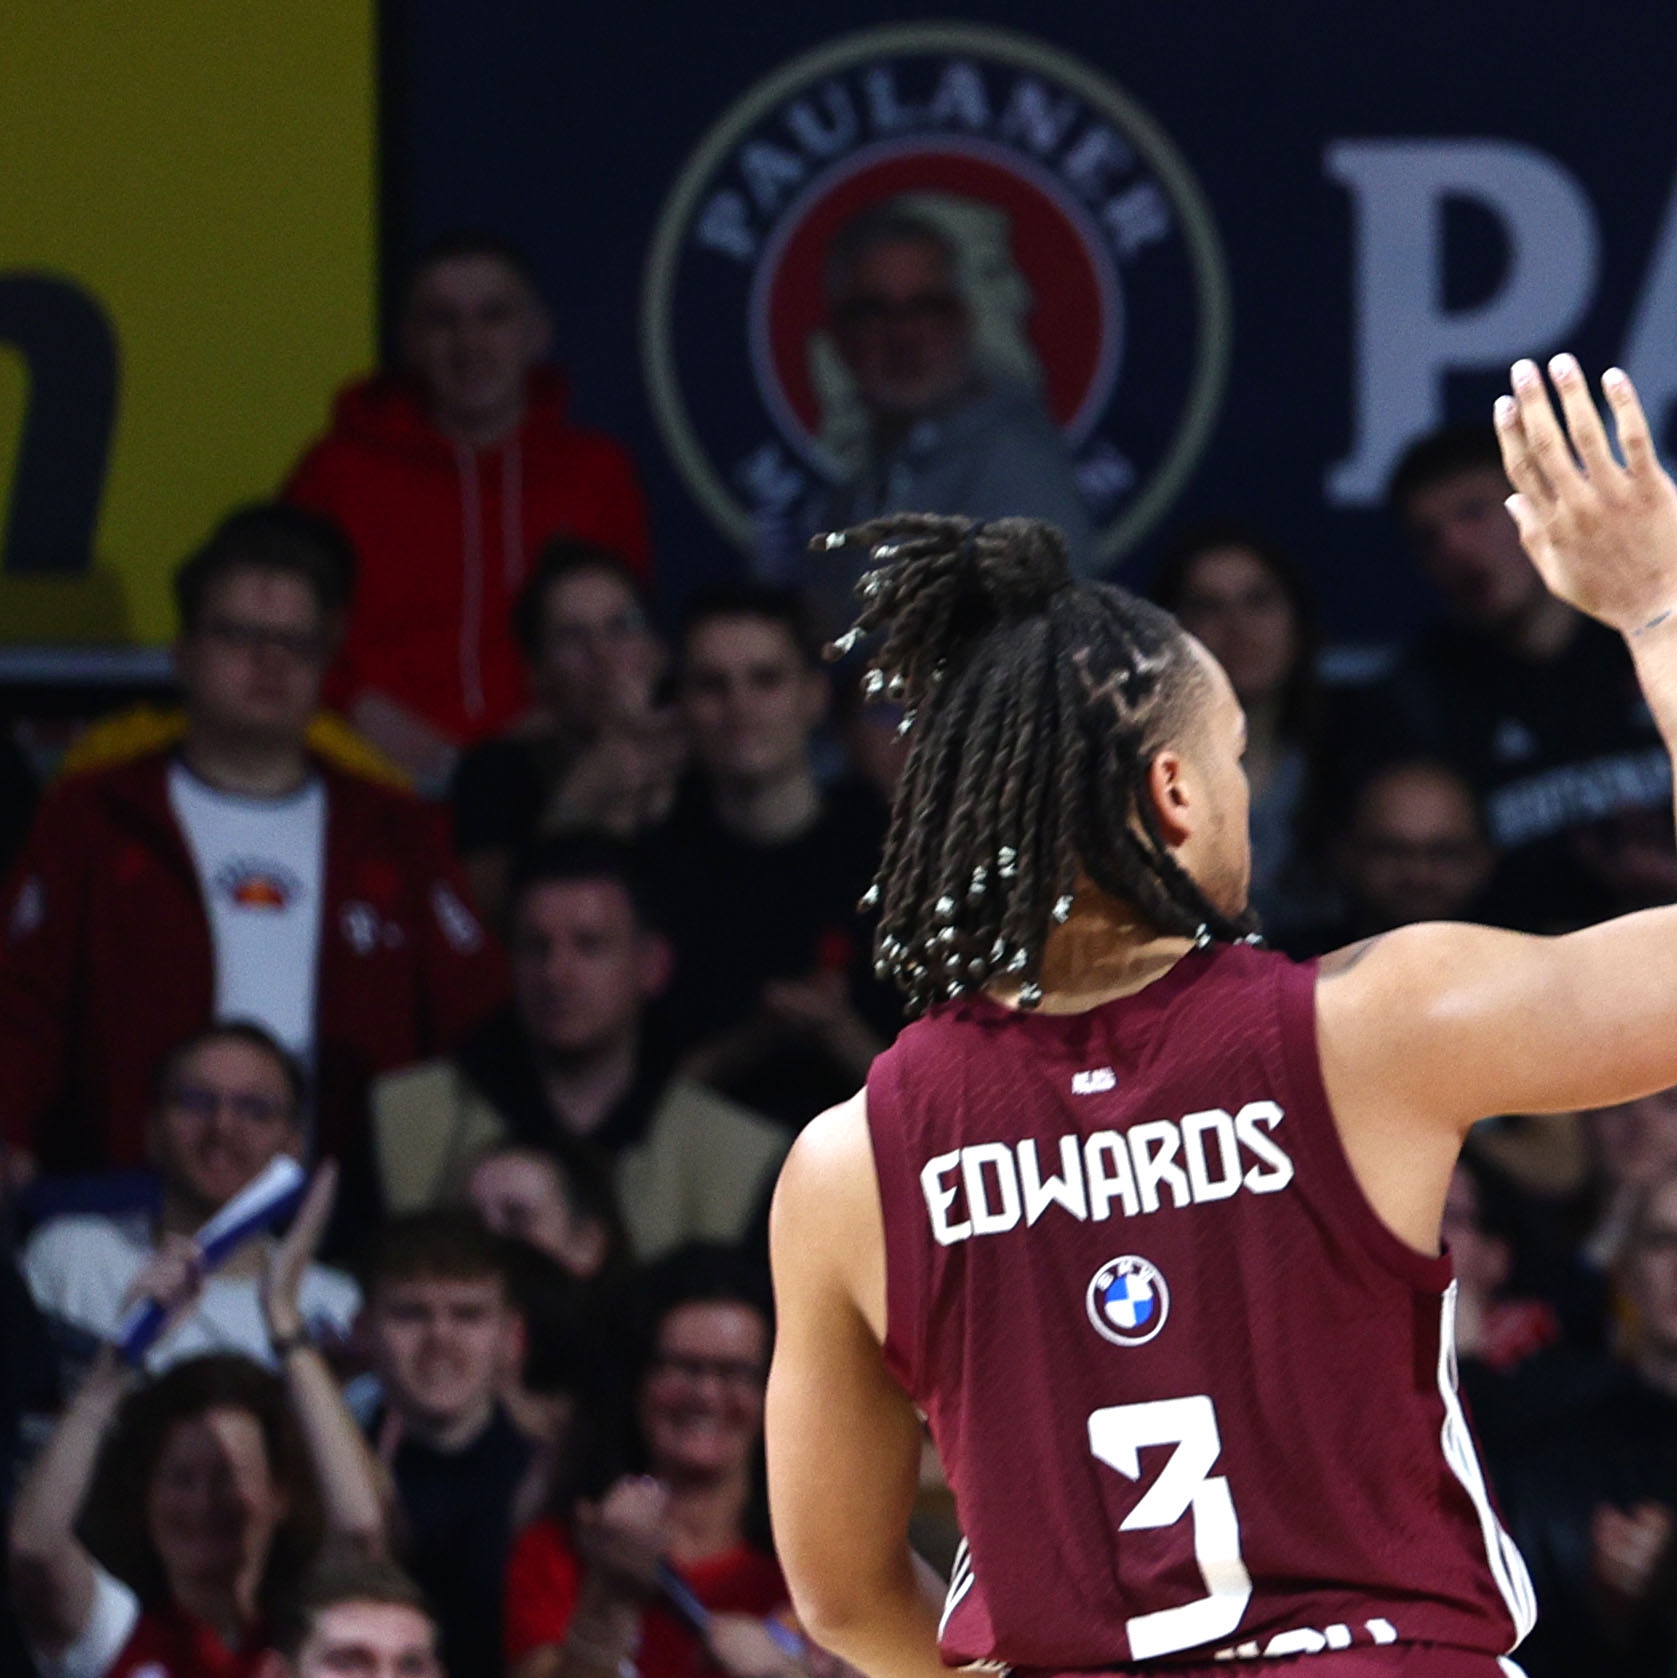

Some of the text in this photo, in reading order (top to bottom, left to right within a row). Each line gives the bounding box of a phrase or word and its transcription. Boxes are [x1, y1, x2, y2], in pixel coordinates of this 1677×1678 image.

[700, 60, 1172, 262] PAULANER
[920, 1100, 1294, 1246] EDWARDS
[1087, 1395, 1252, 1661] 3
